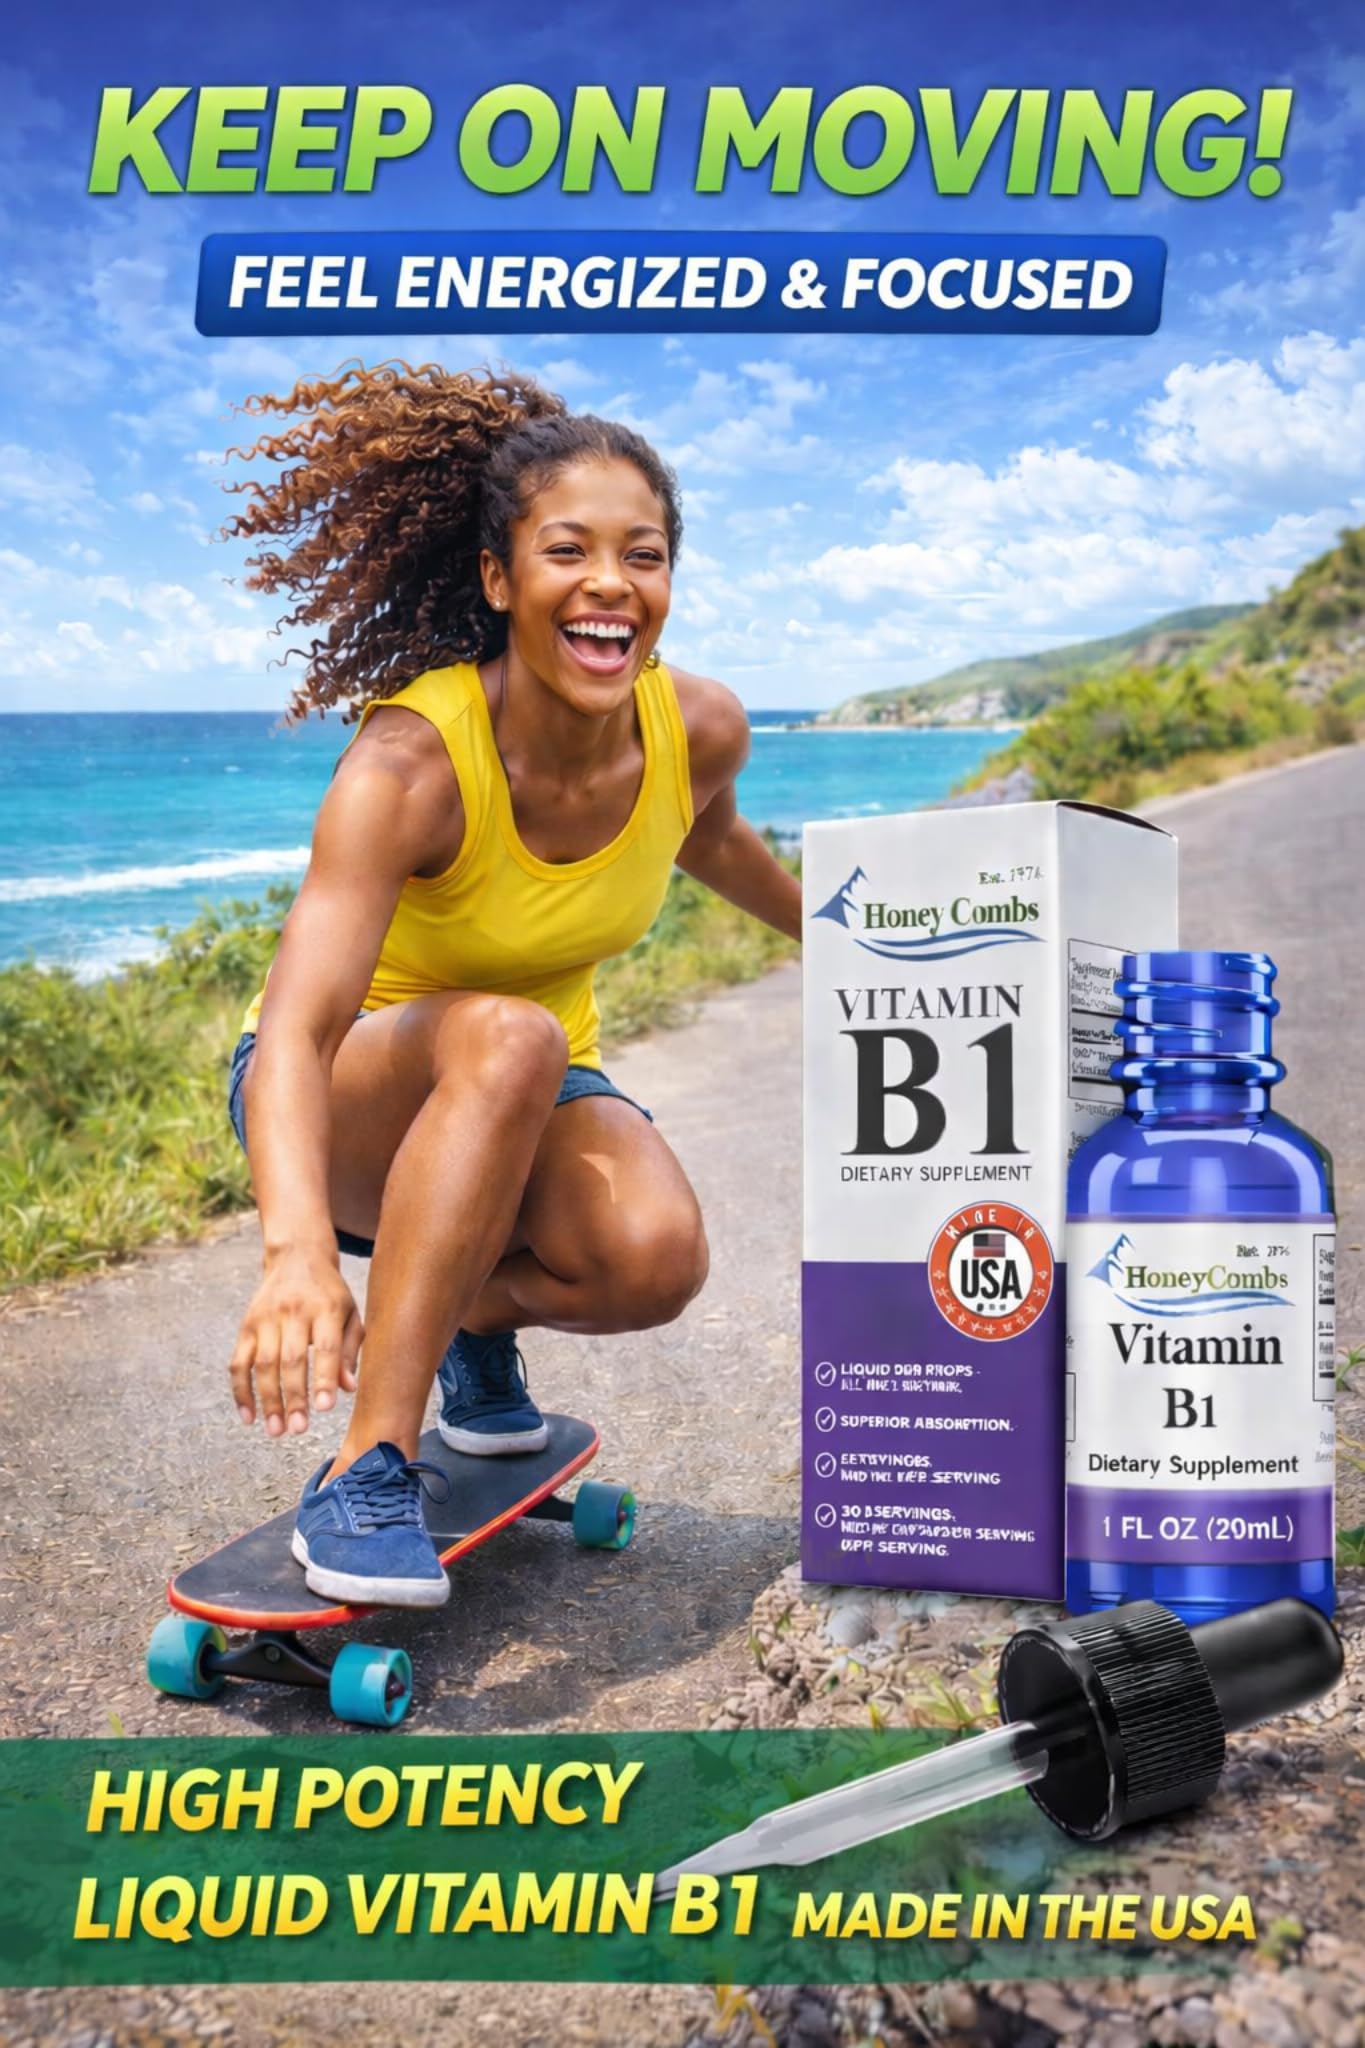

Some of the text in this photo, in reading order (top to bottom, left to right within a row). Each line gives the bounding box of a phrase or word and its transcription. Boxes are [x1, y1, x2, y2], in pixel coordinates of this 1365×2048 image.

[863, 896, 1040, 936] Honey Combs
[834, 984, 1024, 1022] VITAMIN
[839, 1022, 1030, 1155] B1
[840, 1165, 1032, 1182] DIETARY SUPPLEMENT
[960, 1259, 1023, 1300] USA
[1108, 1323, 1284, 1366] Vitamin
[840, 1363, 890, 1377] LIQUID
[840, 1415, 911, 1429] SUPERIOR
[1162, 1387, 1218, 1429] B1
[1088, 1453, 1161, 1479] Dietary
[1169, 1455, 1299, 1481] Supplement
[1103, 1515, 1295, 1542] 1 FL OZ (20mL)
